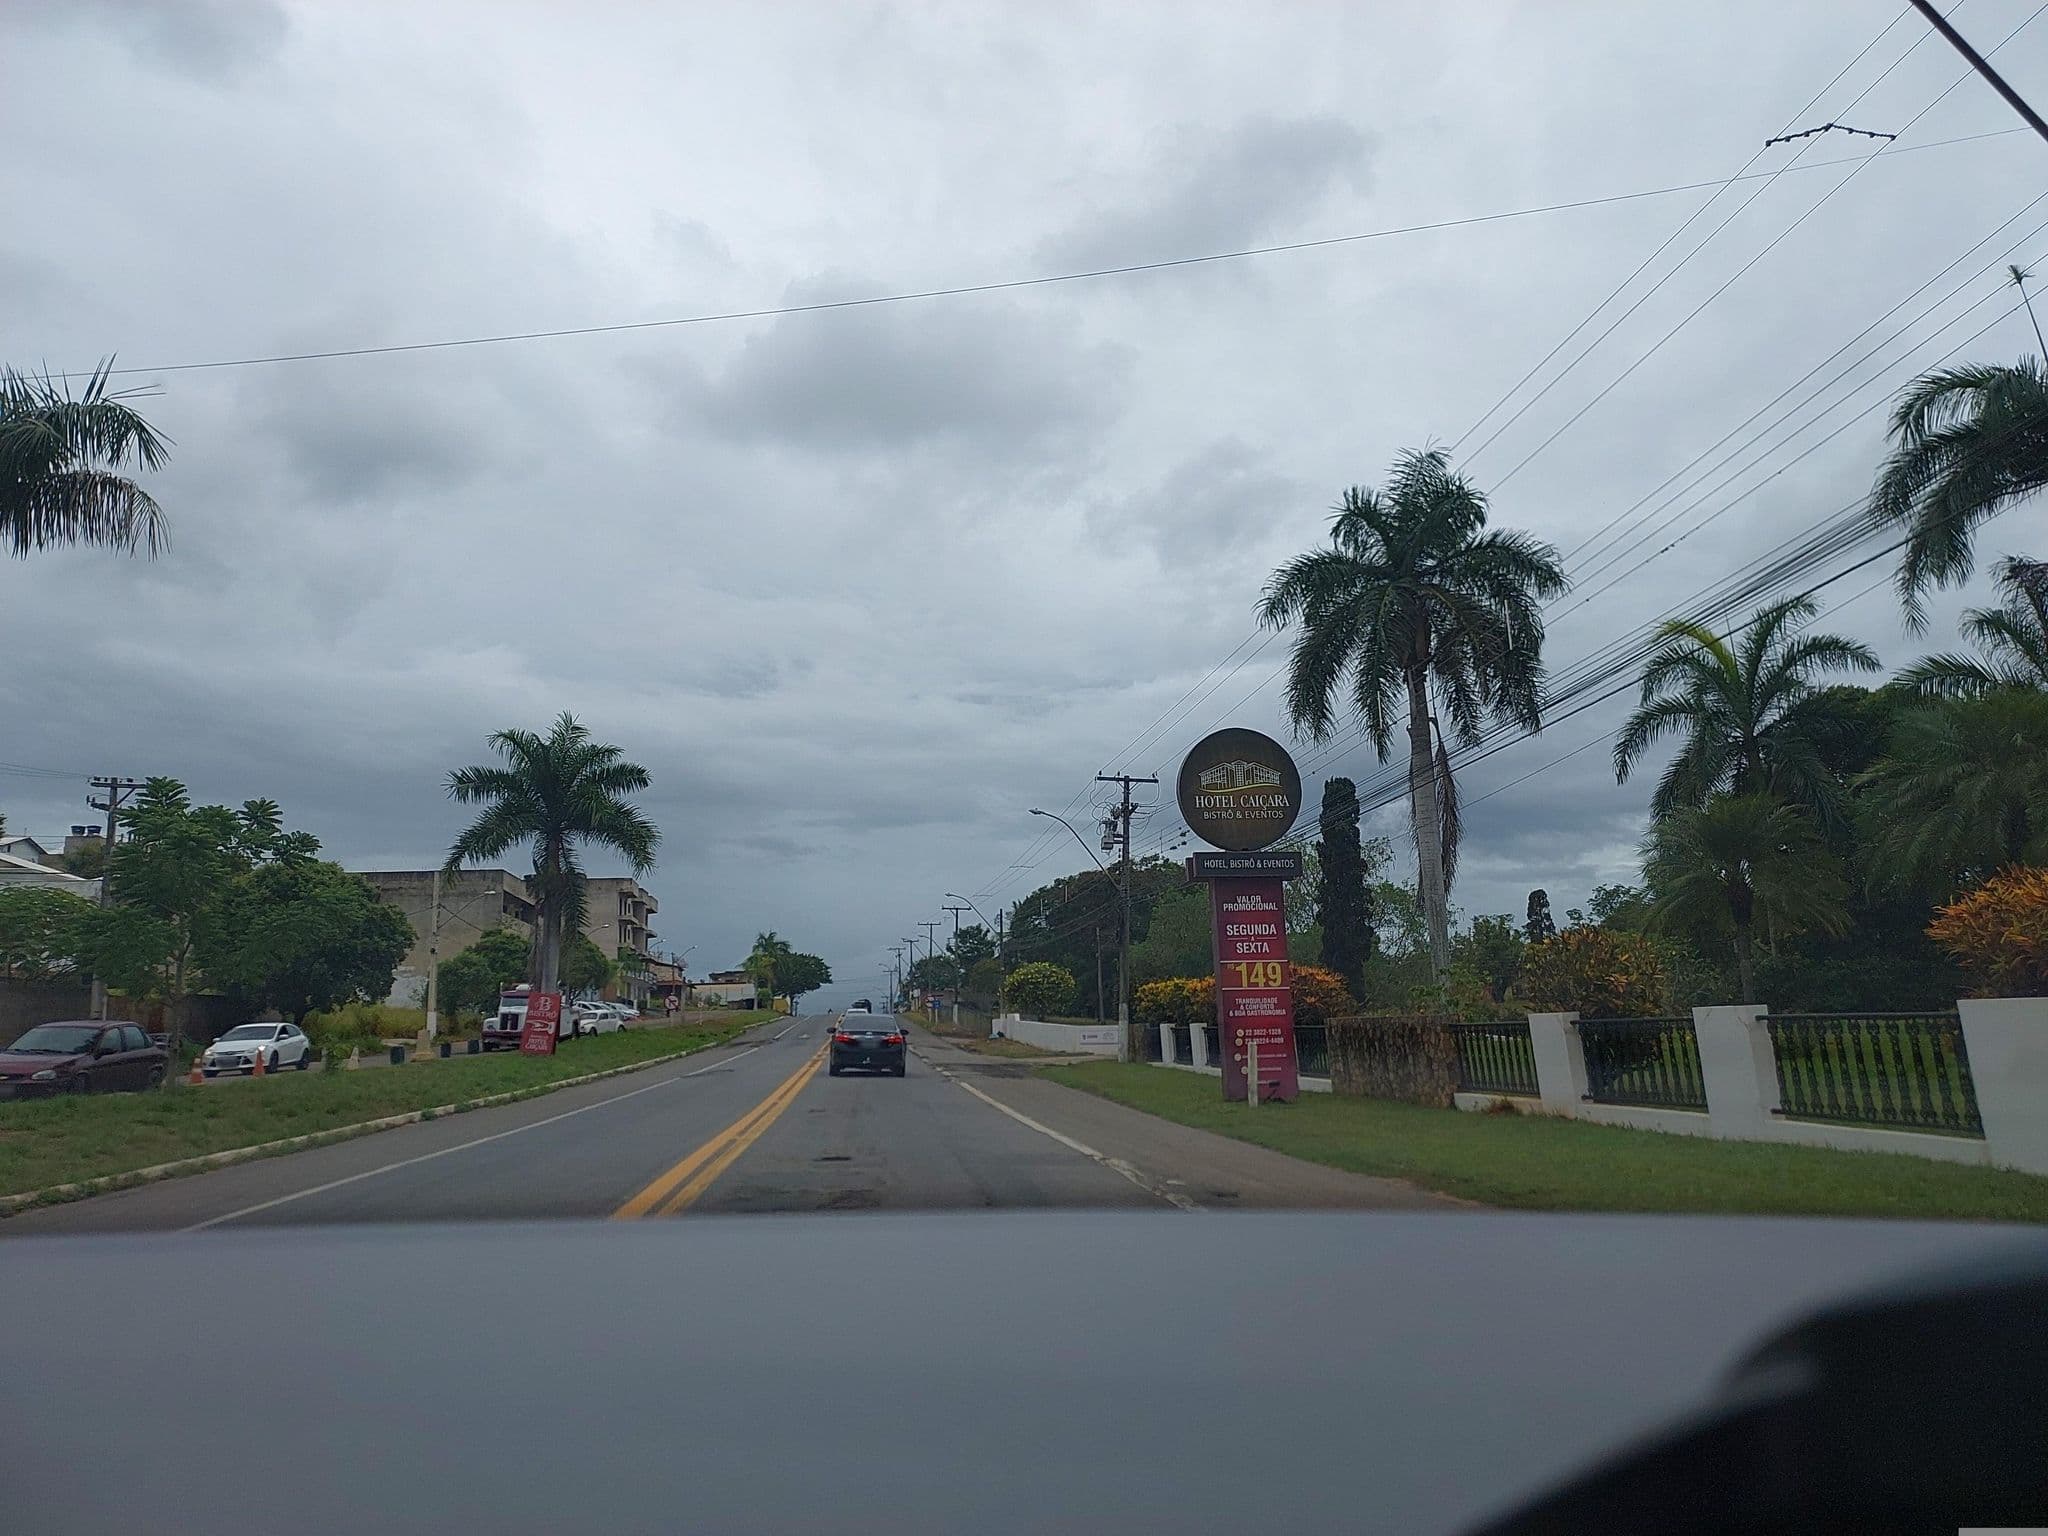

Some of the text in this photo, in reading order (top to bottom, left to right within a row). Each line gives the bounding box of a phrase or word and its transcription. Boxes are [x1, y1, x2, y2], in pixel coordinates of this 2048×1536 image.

[1195, 794, 1290, 810] HOTEL CAIÇARA
[1203, 809, 1234, 819] BISTRÔ
[1245, 810, 1284, 819] EVENTOS
[1204, 858, 1295, 869] HOTEL, BISTRÔ & EVENTOS
[1236, 895, 1262, 904] VALOR
[1223, 902, 1278, 911] PROMOCIONAL
[1226, 923, 1277, 935] SEGUNDA
[1236, 942, 1270, 953] SEXTA
[1235, 962, 1282, 988] 149
[1235, 997, 1278, 1005] TRANQUILIDADE
[1246, 1008, 1286, 1016] GASTRONOMIA
